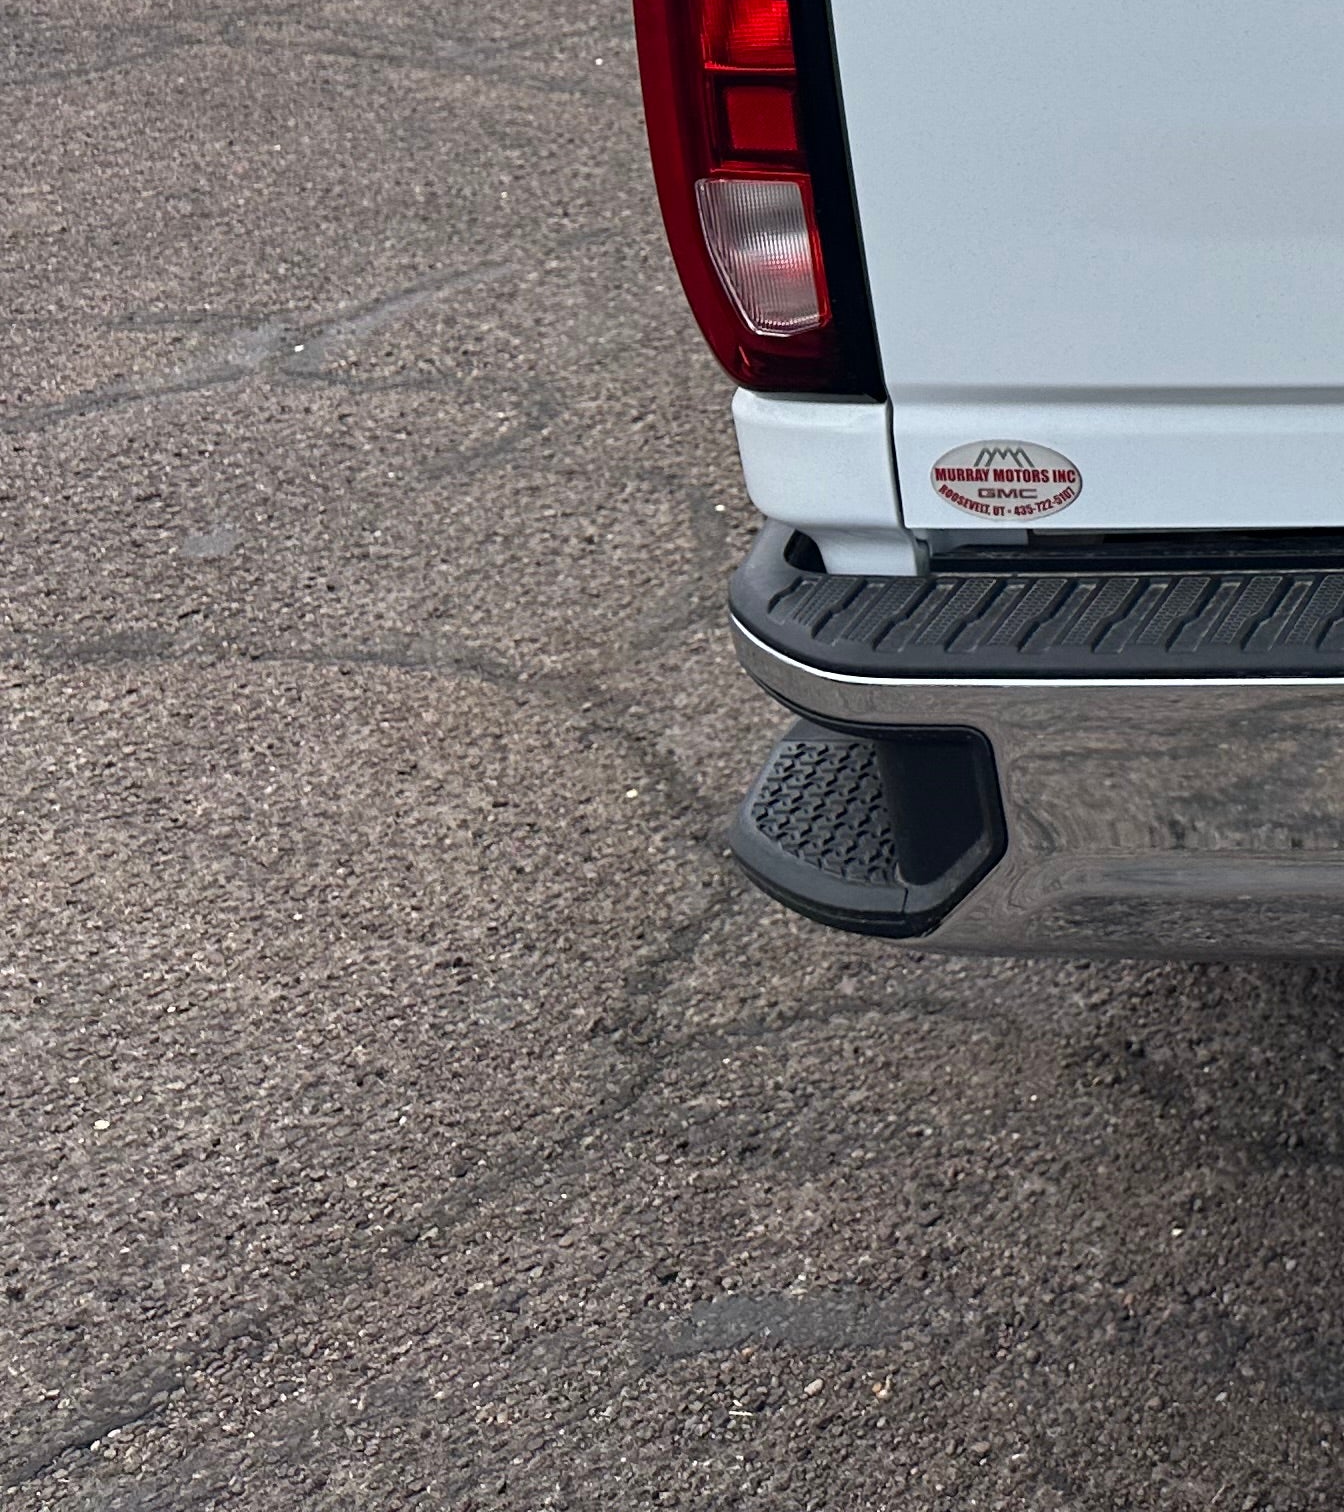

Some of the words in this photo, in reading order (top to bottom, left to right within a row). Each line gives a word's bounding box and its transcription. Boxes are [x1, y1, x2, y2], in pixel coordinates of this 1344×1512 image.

[935, 468, 990, 482] MURRAY
[993, 469, 1050, 483] MOTORS
[1053, 469, 1076, 483] INC
[978, 488, 1038, 499] GMC
[992, 506, 1005, 516] UT
